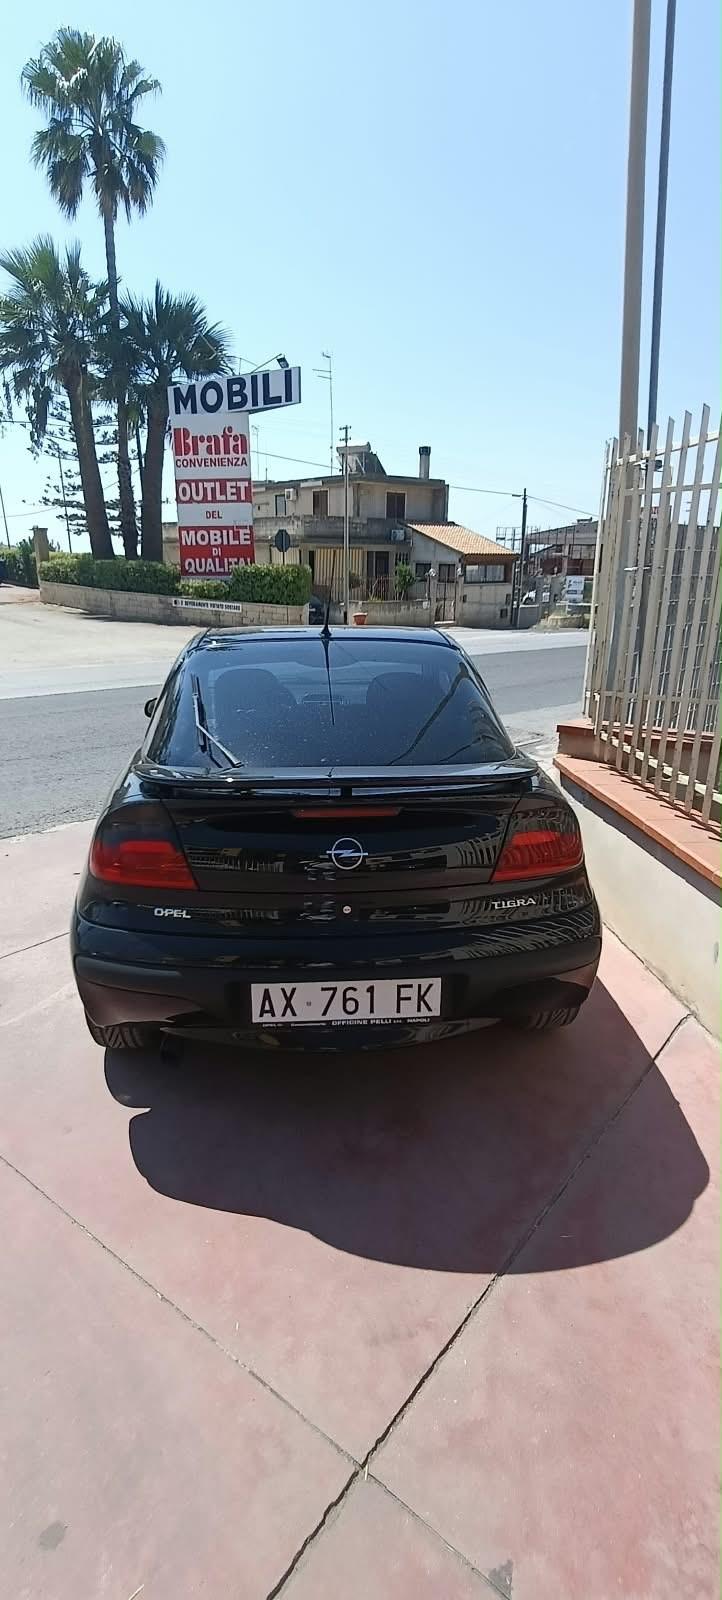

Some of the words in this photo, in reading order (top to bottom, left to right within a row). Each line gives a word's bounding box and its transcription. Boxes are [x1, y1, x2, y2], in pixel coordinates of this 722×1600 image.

[173, 369, 293, 414] MOBILI
[173, 425, 248, 457] Brafa
[175, 456, 248, 468] CONVENIENZA
[178, 481, 249, 501] OUTLET
[205, 510, 223, 519] DEL
[181, 529, 251, 546] MOBILE
[212, 547, 222, 557] DI
[491, 898, 536, 909] TIGRA
[154, 908, 191, 918] OPEL
[258, 987, 298, 1018] AX
[320, 985, 375, 1017] 761
[395, 983, 435, 1014] FK
